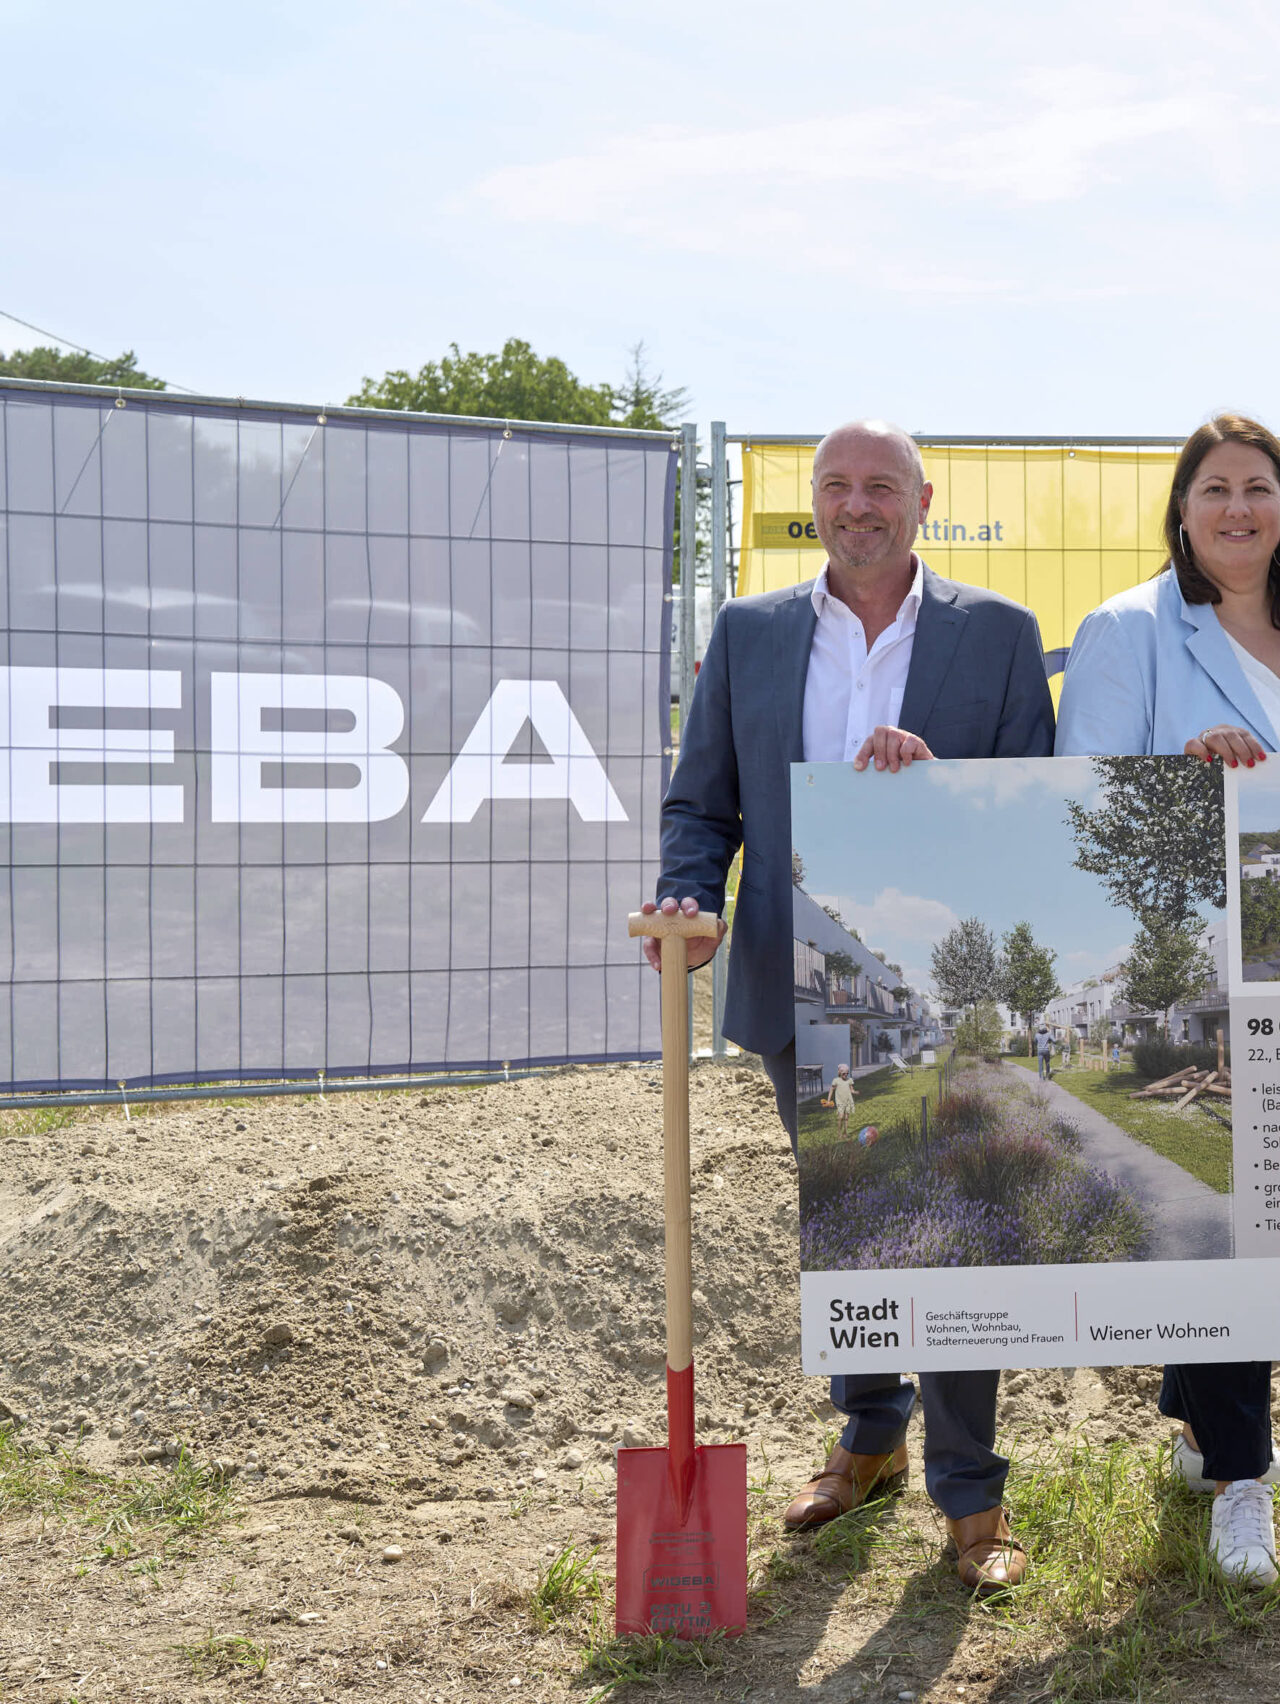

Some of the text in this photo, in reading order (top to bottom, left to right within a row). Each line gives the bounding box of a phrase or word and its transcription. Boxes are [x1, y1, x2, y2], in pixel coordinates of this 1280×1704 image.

[1246, 1018, 1274, 1036] 98
[1247, 1048, 1272, 1063] 22.,
[830, 1298, 899, 1322] Stadt
[925, 1310, 1009, 1322] Geschäftsgruppe
[926, 1322, 1021, 1334] Wohnen, Wohnbau,
[1090, 1322, 1230, 1341] Wiener Wohnen
[830, 1326, 899, 1349] Wien
[926, 1334, 1064, 1347] Stadterneuerung und Frauen
